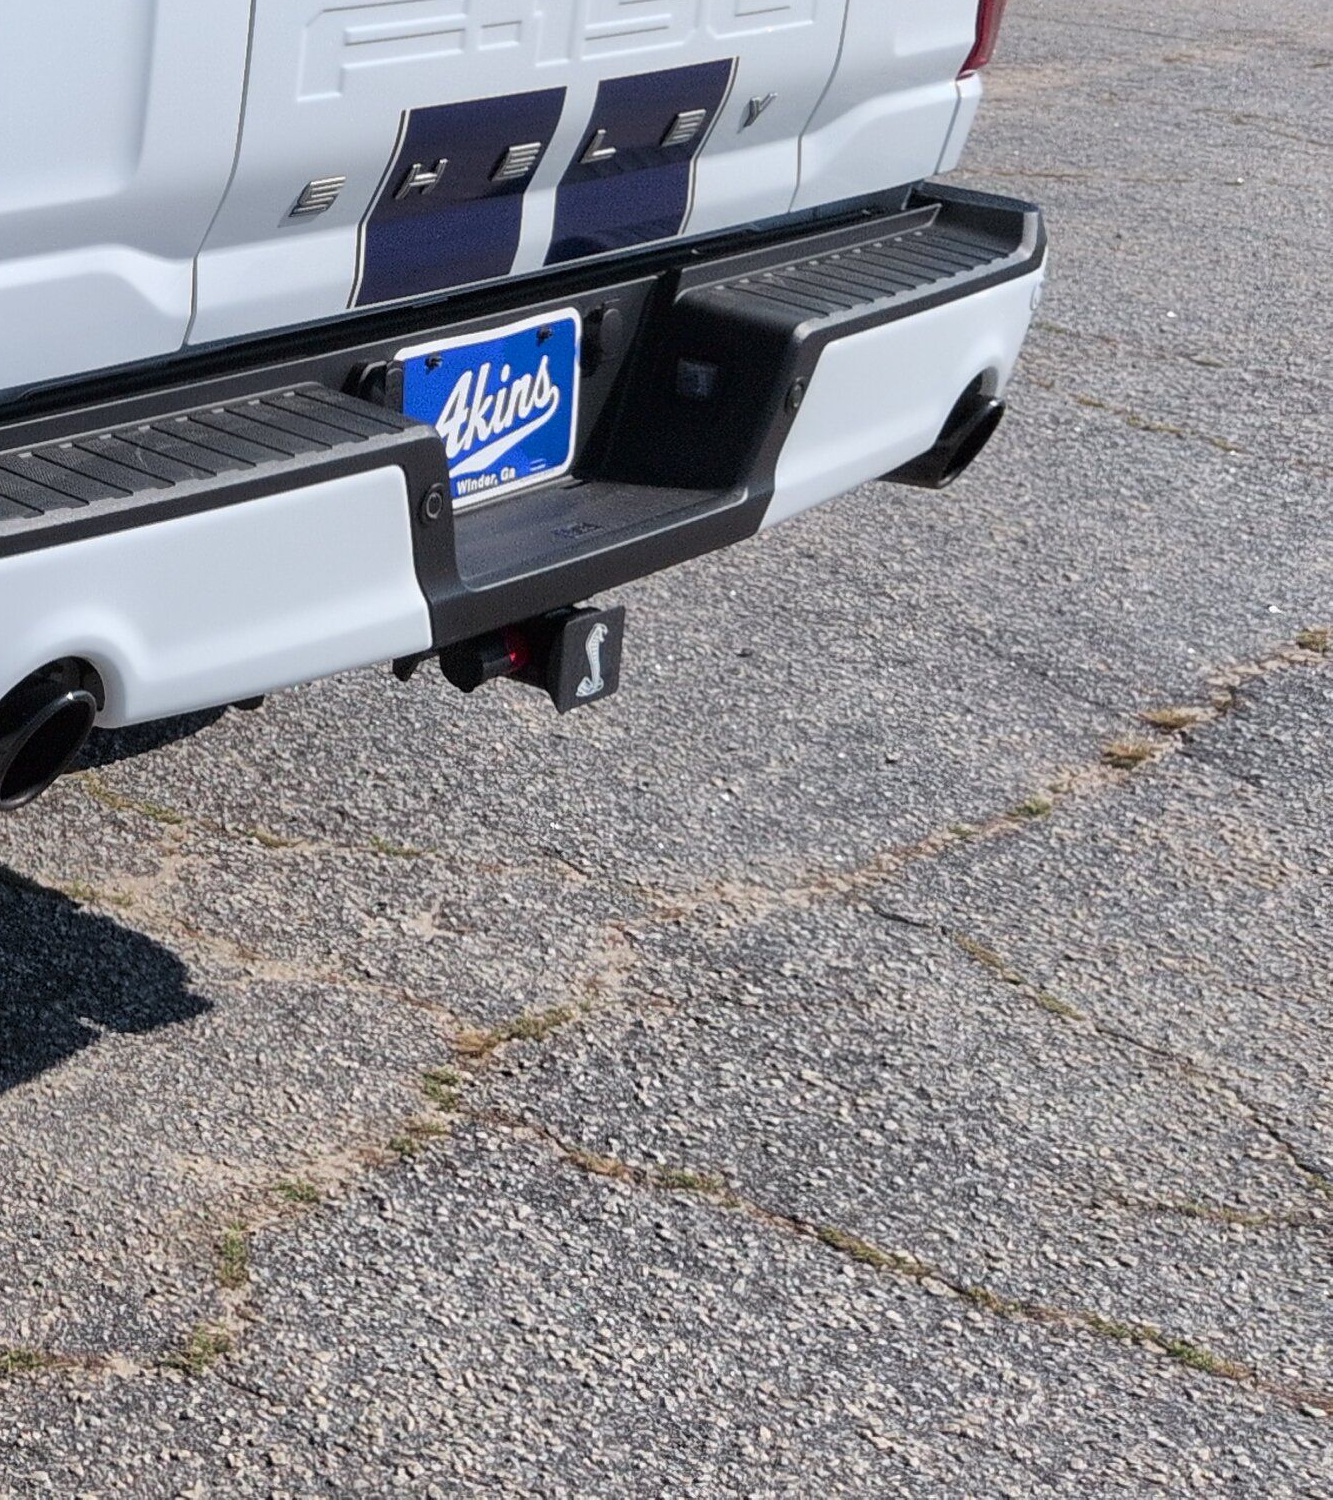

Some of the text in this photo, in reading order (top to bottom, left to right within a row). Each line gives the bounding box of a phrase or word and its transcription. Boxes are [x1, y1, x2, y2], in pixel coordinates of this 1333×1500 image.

[288, 92, 778, 217] SHELBY
[435, 355, 560, 478] Akins
[457, 473, 498, 495] Winder,
